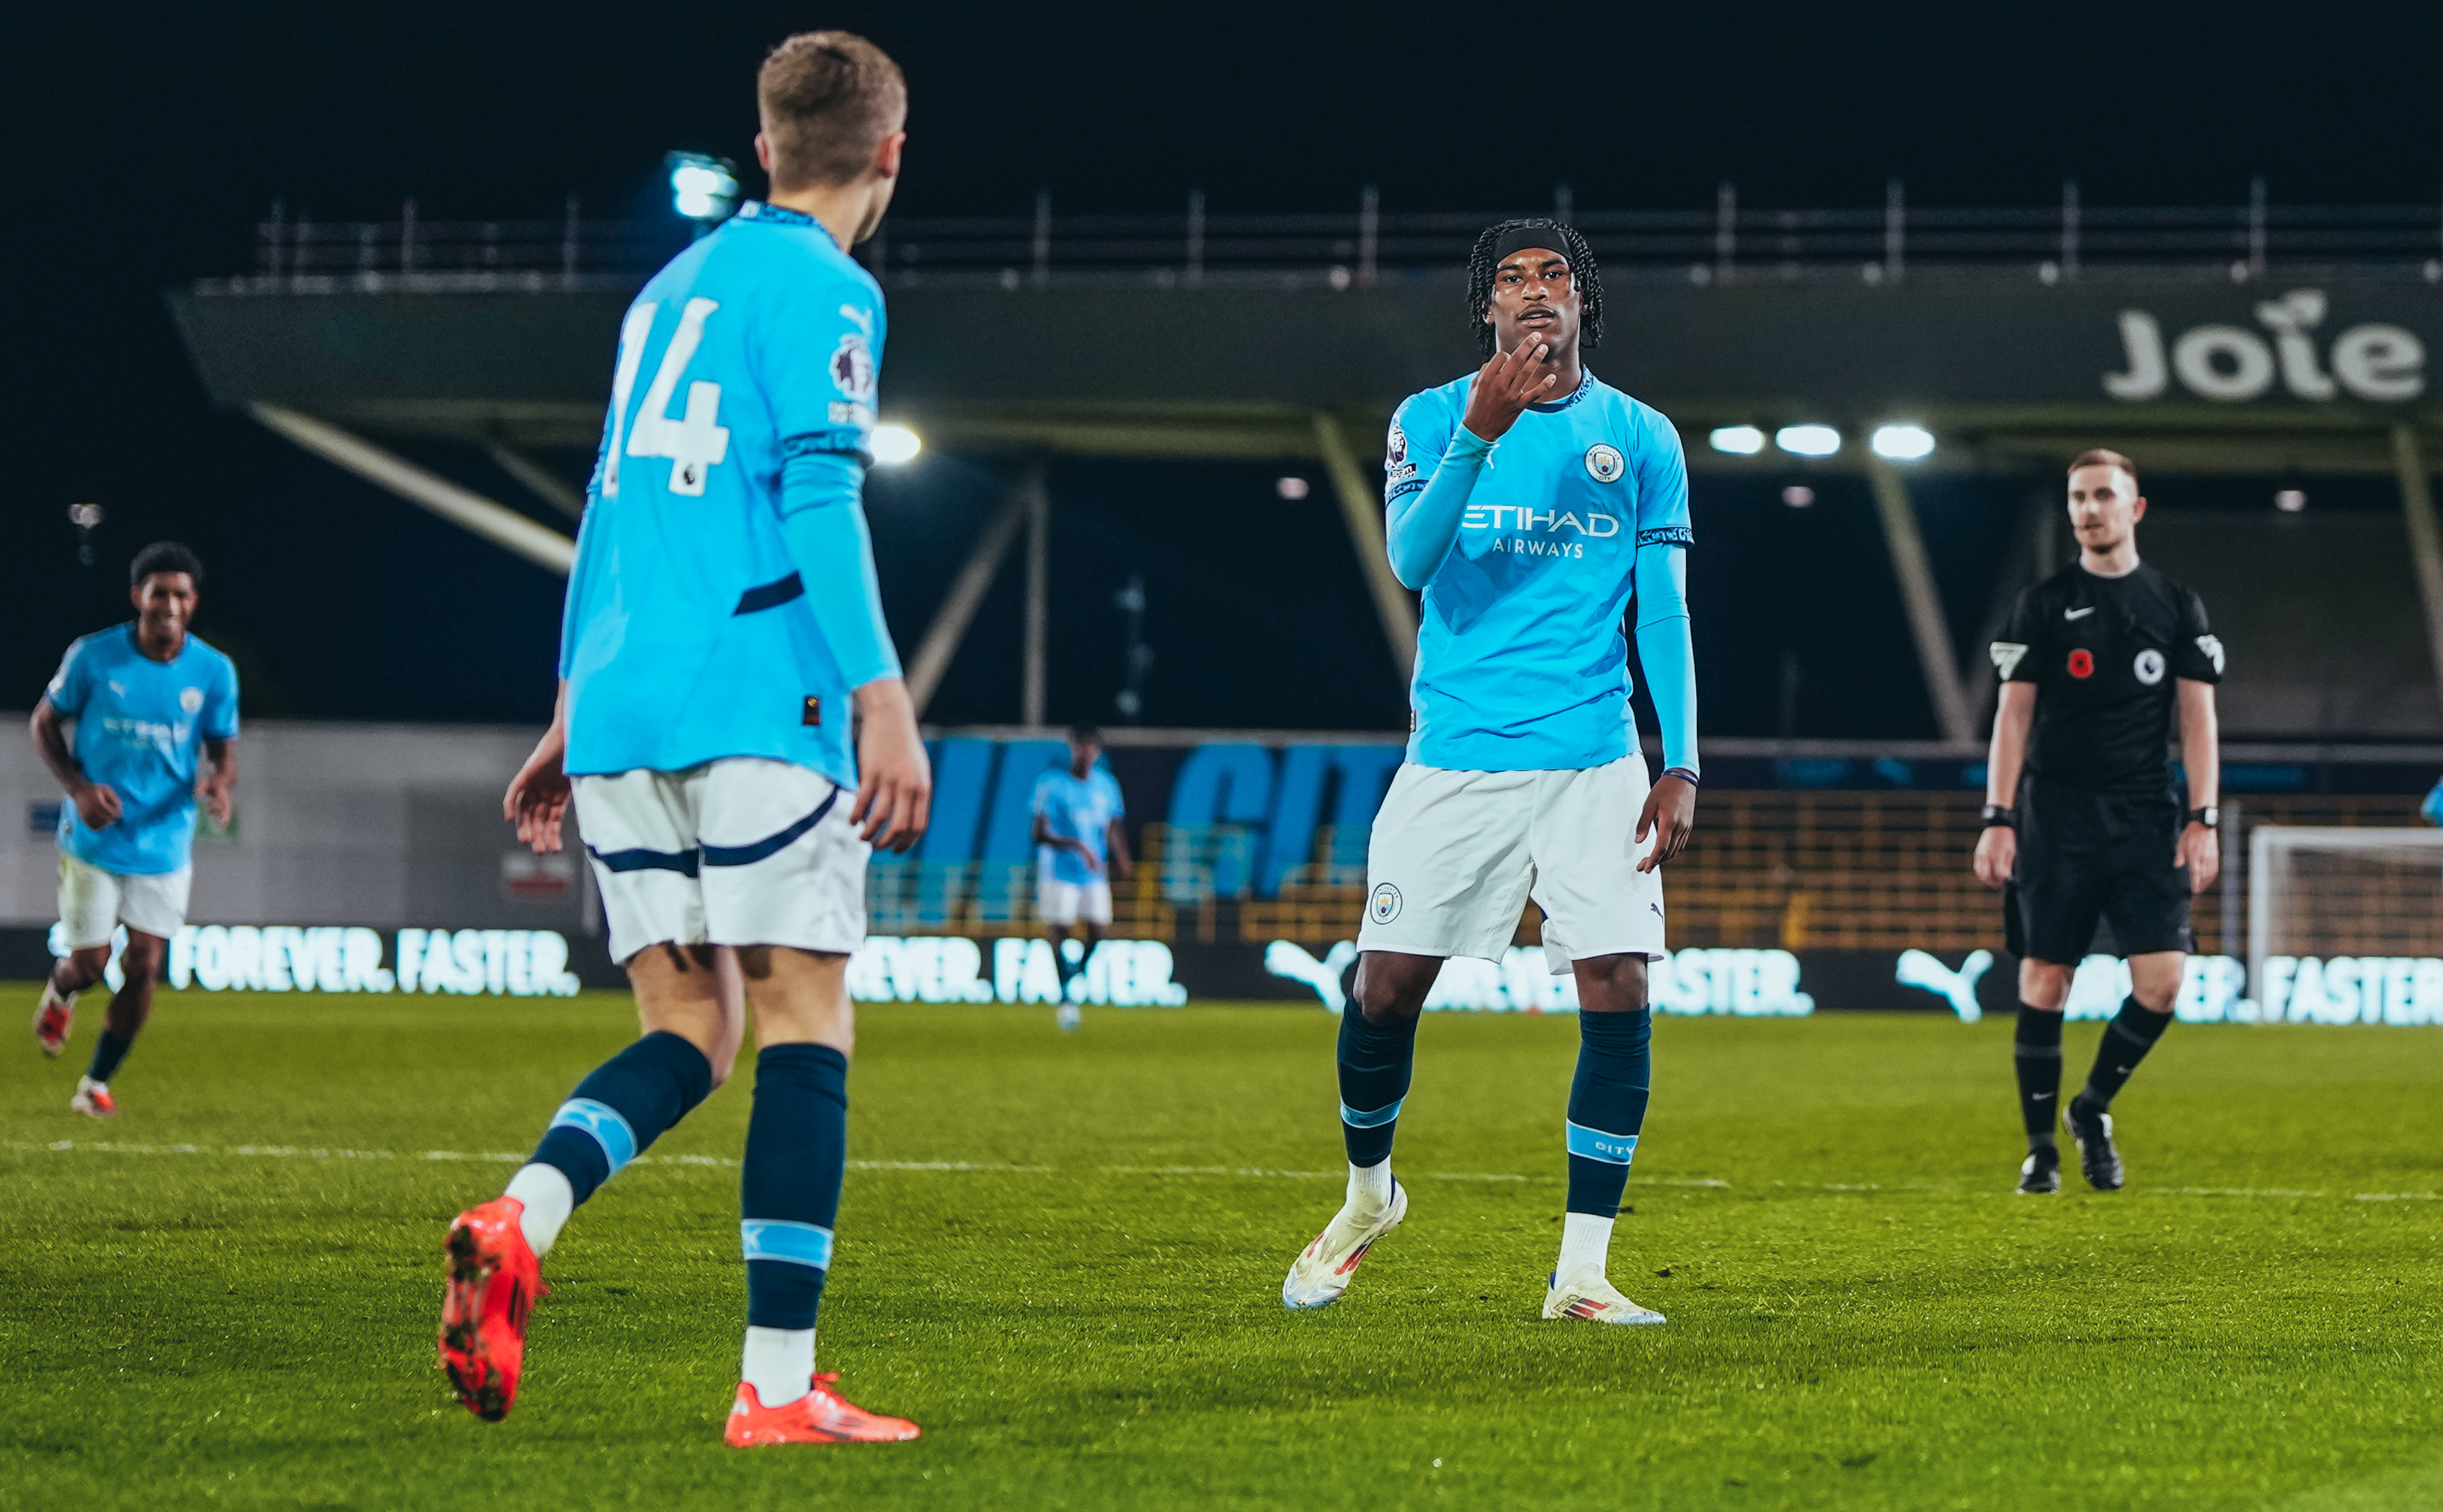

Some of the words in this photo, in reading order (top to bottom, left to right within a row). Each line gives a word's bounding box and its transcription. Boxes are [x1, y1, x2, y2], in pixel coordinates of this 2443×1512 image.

[2102, 290, 2426, 401] Joie
[602, 297, 730, 497] 14
[1462, 504, 1620, 538] ETIHAD
[1492, 537, 1584, 559] AIRWAYS
